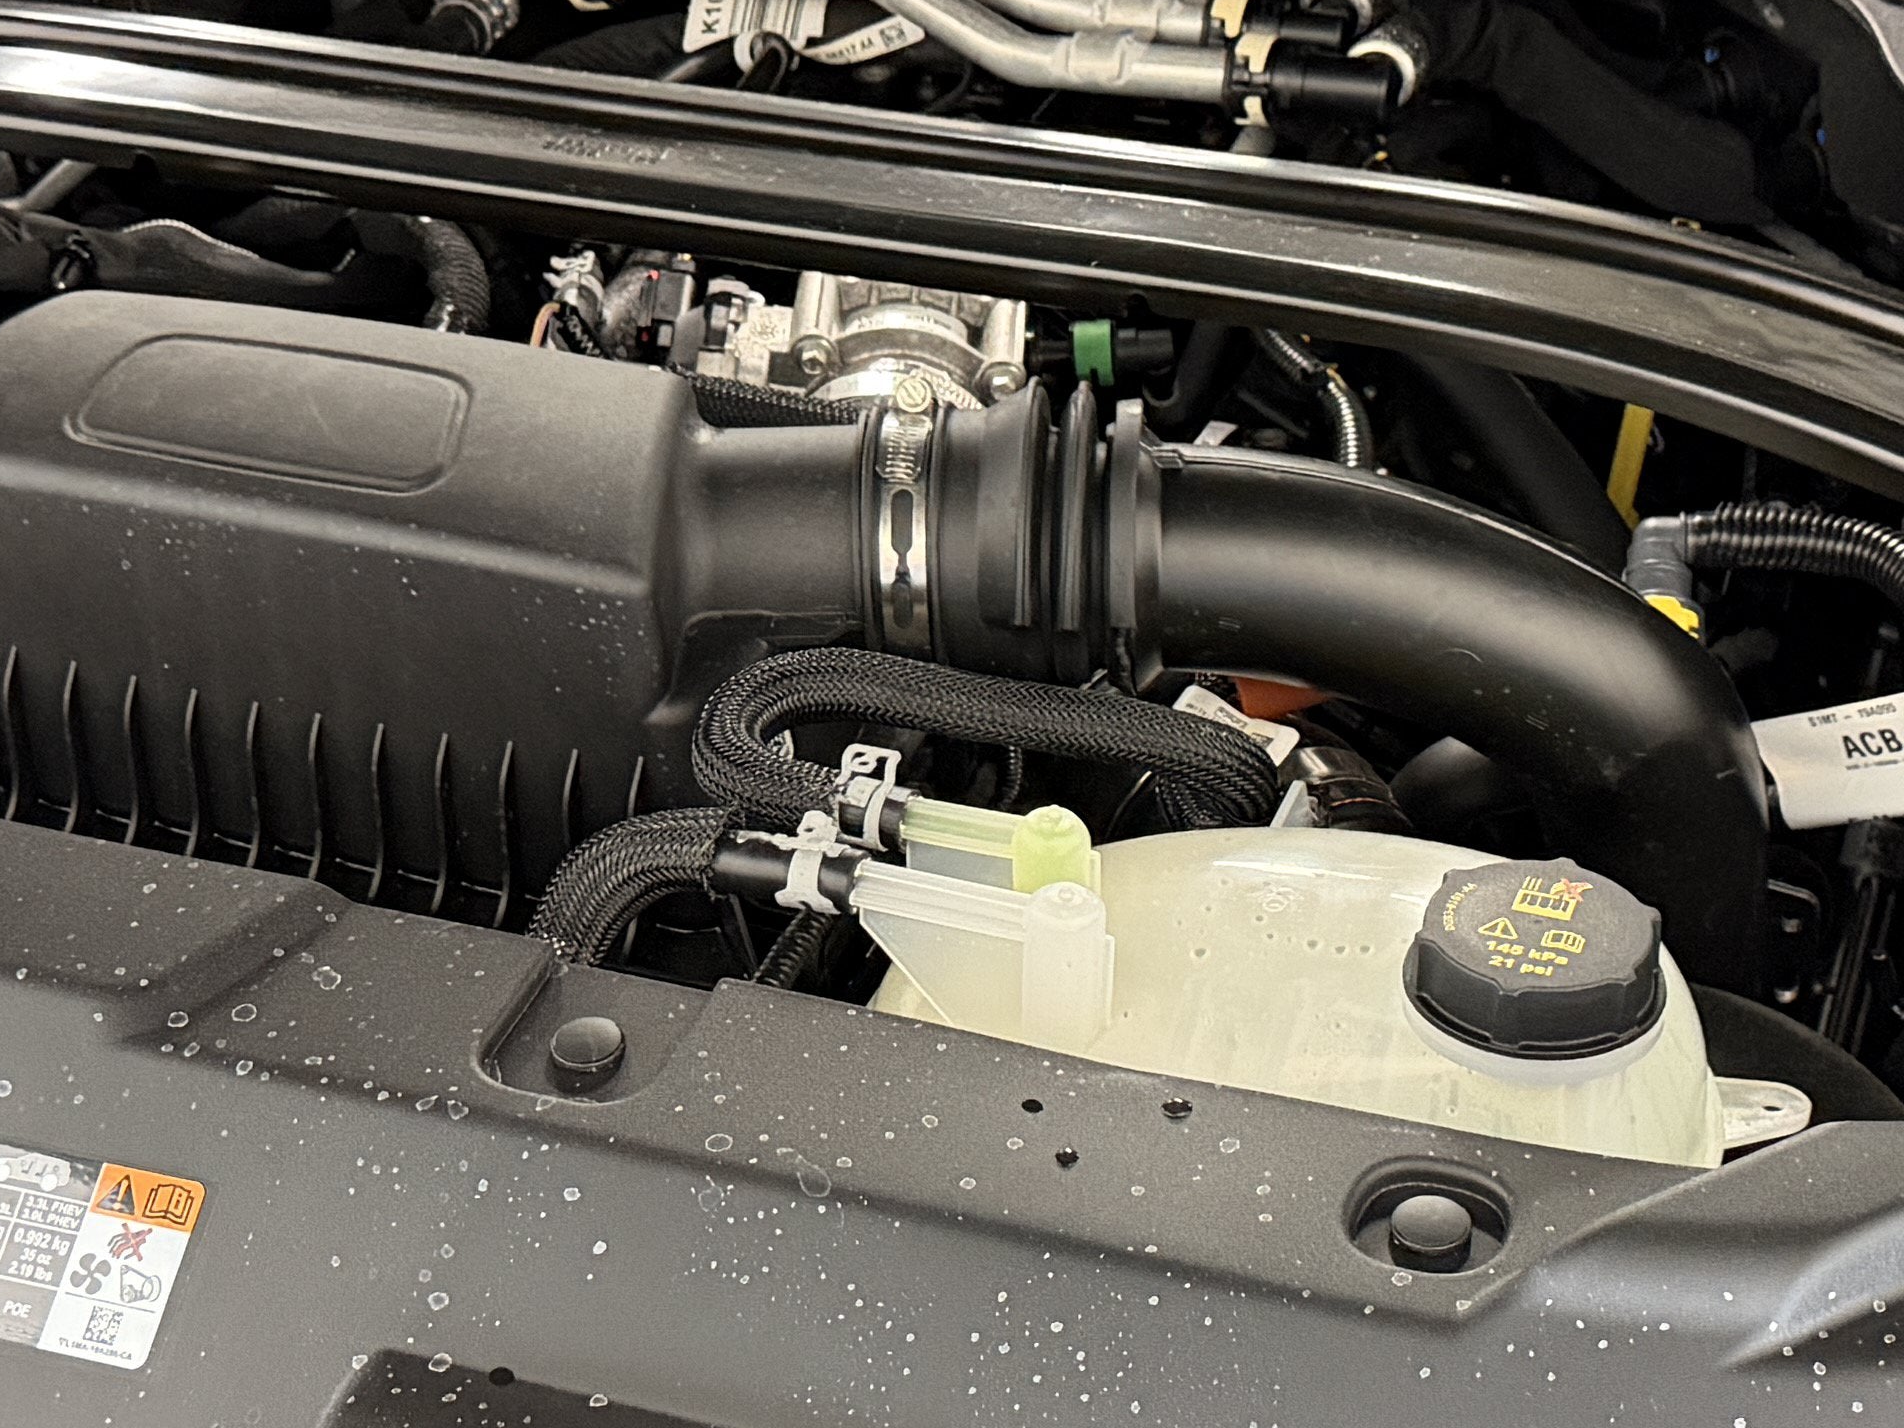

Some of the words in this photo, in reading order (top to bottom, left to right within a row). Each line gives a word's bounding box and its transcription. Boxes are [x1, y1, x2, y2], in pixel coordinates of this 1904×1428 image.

[1842, 729, 1903, 759] ACB
[1487, 940, 1525, 956] 145
[1528, 949, 1568, 965] kPa
[1488, 955, 1515, 969] 21
[1520, 963, 1553, 976] psi
[50, 1199, 84, 1216] FHEV
[46, 1212, 80, 1230] PHEV
[13, 1228, 53, 1249] 0.992
[51, 1235, 71, 1256] kg
[19, 1248, 36, 1262] 35
[36, 1253, 53, 1266] oz
[7, 1261, 33, 1278] 2.19
[33, 1267, 53, 1282] lbs
[2, 1300, 32, 1318] POE
